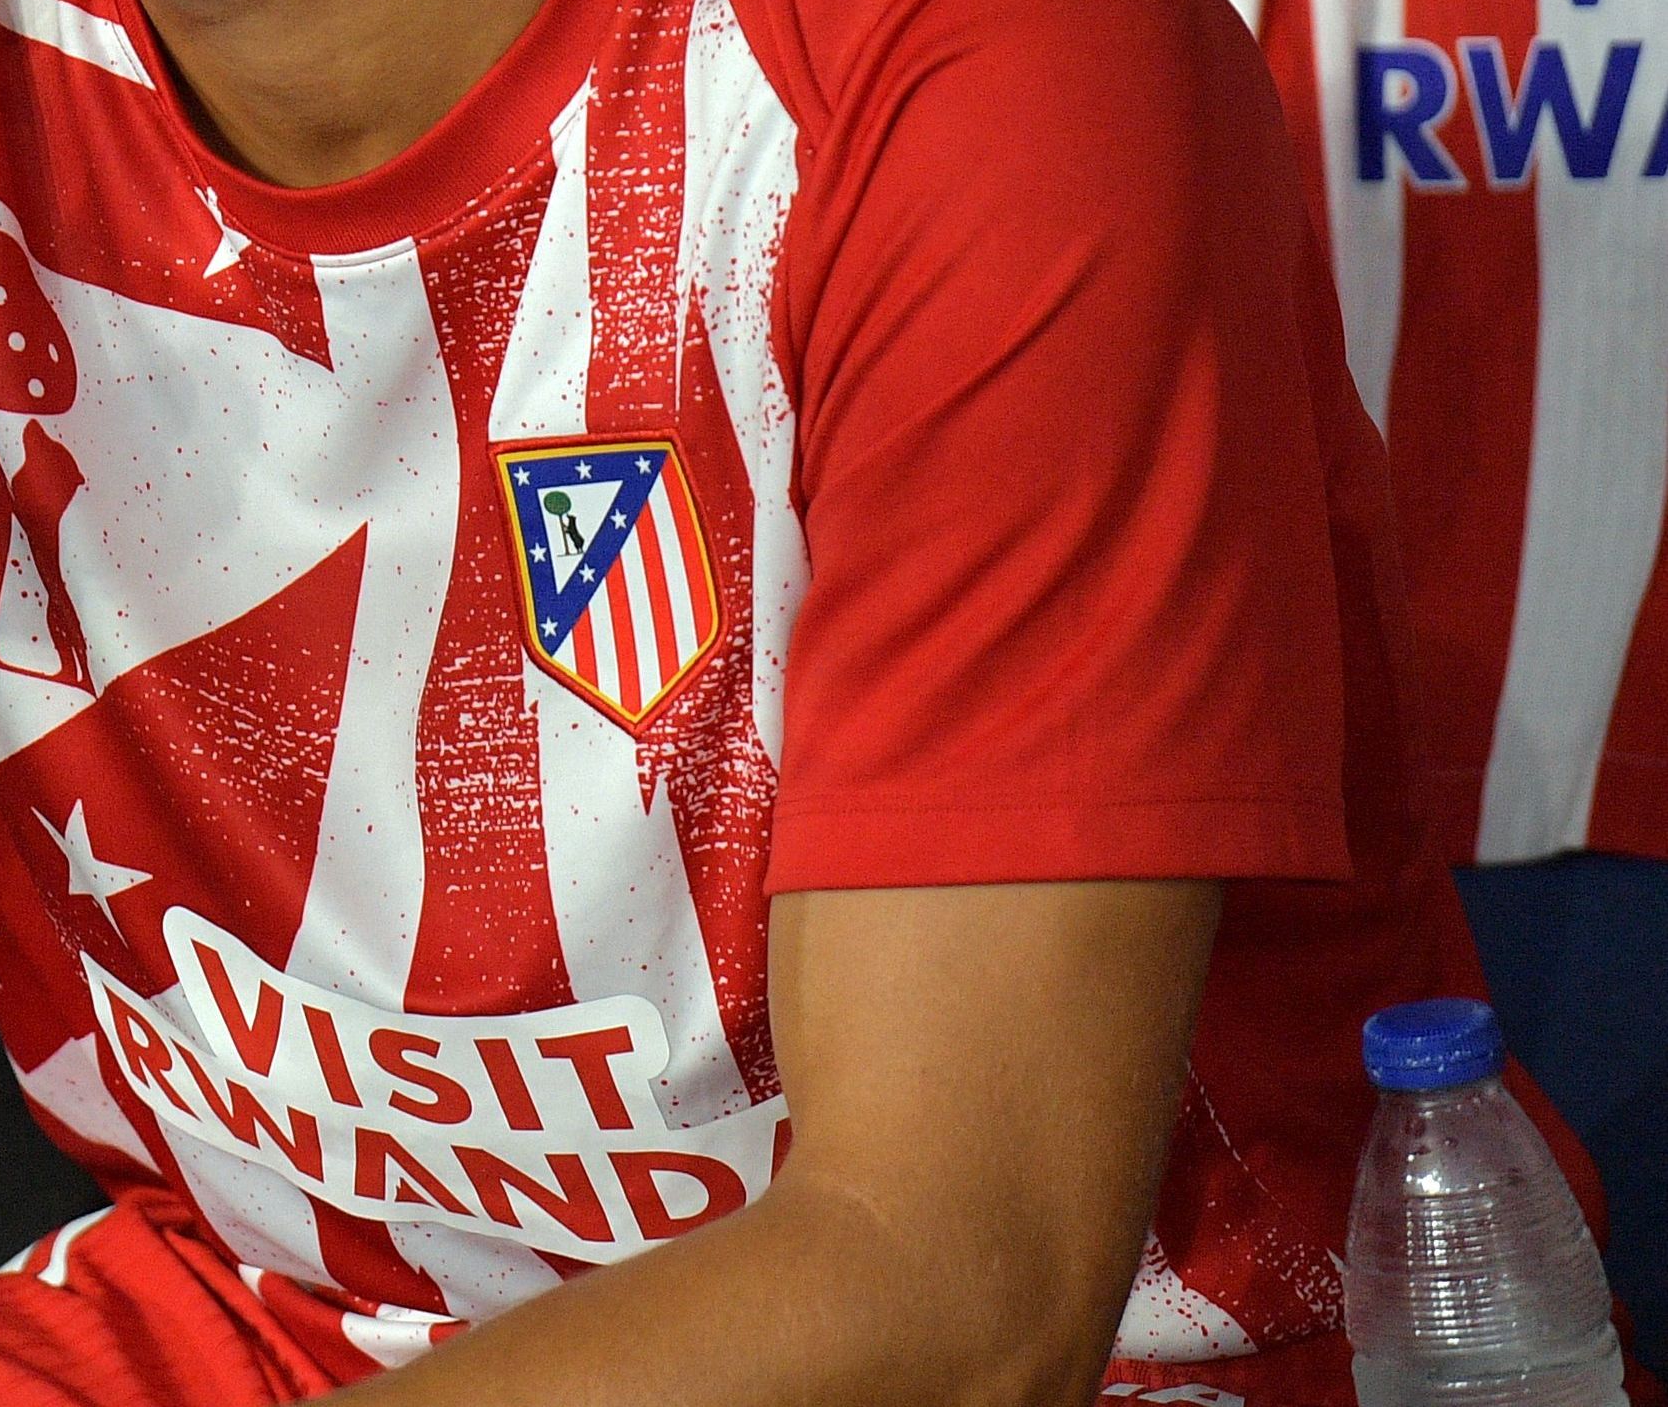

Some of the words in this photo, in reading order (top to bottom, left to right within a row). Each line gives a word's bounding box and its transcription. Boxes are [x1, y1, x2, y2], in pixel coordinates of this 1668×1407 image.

[1355, 39, 1668, 184] RW
[100, 980, 793, 1244] RWAND
[191, 938, 636, 1134] VISIT
